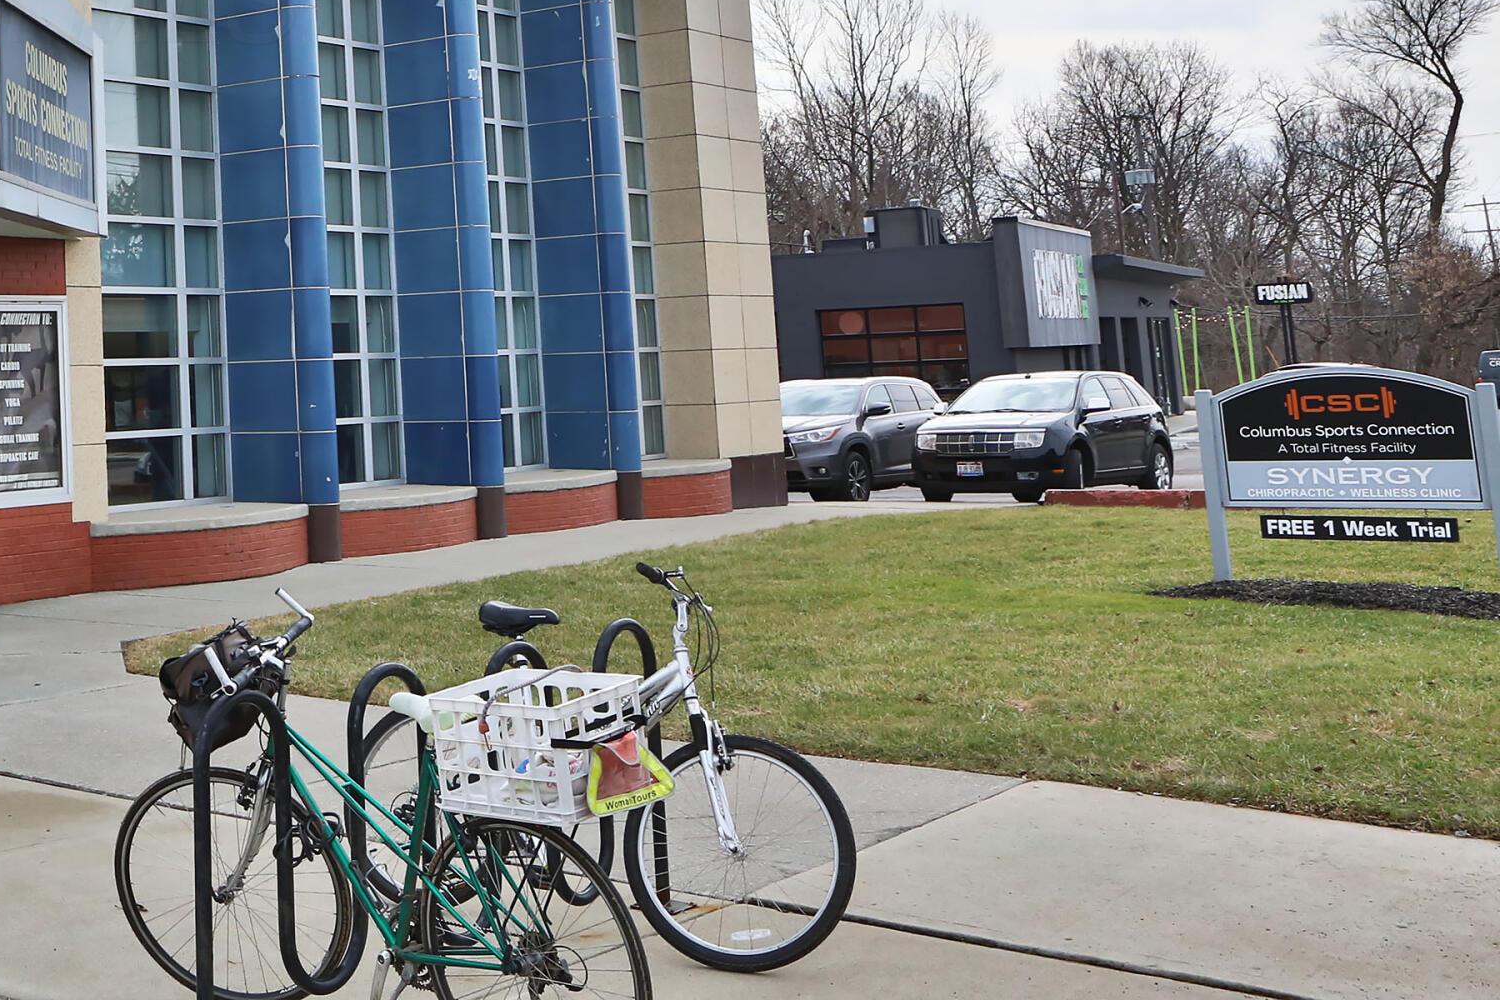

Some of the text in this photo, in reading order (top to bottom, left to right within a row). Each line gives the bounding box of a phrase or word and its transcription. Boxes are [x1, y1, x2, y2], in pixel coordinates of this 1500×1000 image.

[25, 41, 68, 96] COLUMBUS
[5, 79, 88, 150] SPORTS CONNECTION
[14, 136, 85, 180] TOTAL FITNESS FACILITY
[1257, 283, 1308, 301] FUSIAN
[0, 312, 41, 326] CONNECTION
[1300, 393, 1381, 413] CSC
[1239, 423, 1455, 438] Columbus Sports Connection
[1277, 442, 1417, 455] A Total Fitness Facility
[1267, 466, 1433, 485] SYNERGY
[1247, 488, 1462, 498] CHIROPRACTIC WELLNESS CLINIC
[1265, 519, 1452, 538] FREE 1 Week Trial
